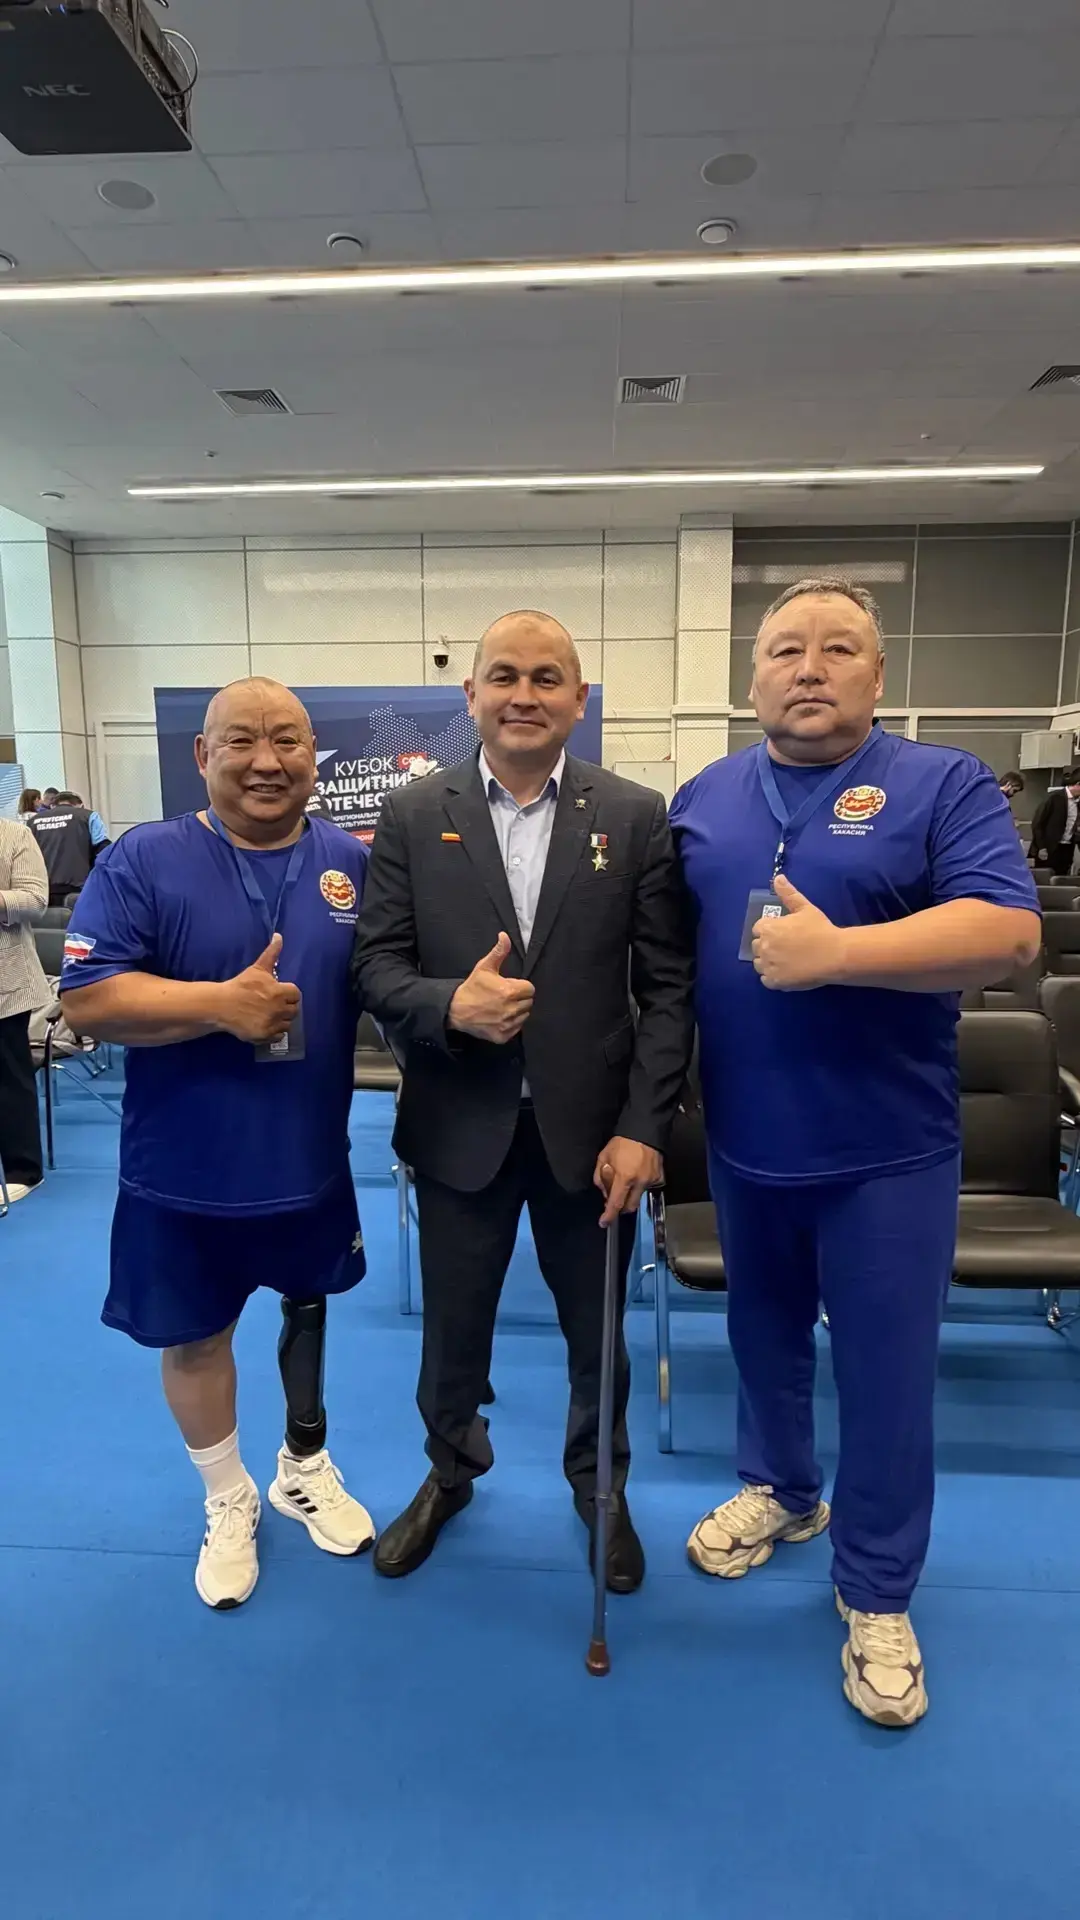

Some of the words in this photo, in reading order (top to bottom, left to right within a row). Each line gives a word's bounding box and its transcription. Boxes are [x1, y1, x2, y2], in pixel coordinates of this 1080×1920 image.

[22, 84, 91, 97] NEC
[334, 755, 395, 777] КУБОК
[314, 772, 413, 796] ЗАЩИТНИ
[324, 792, 390, 812] ТЕЧЕС
[37, 821, 67, 830] ОБЛАСТЬ
